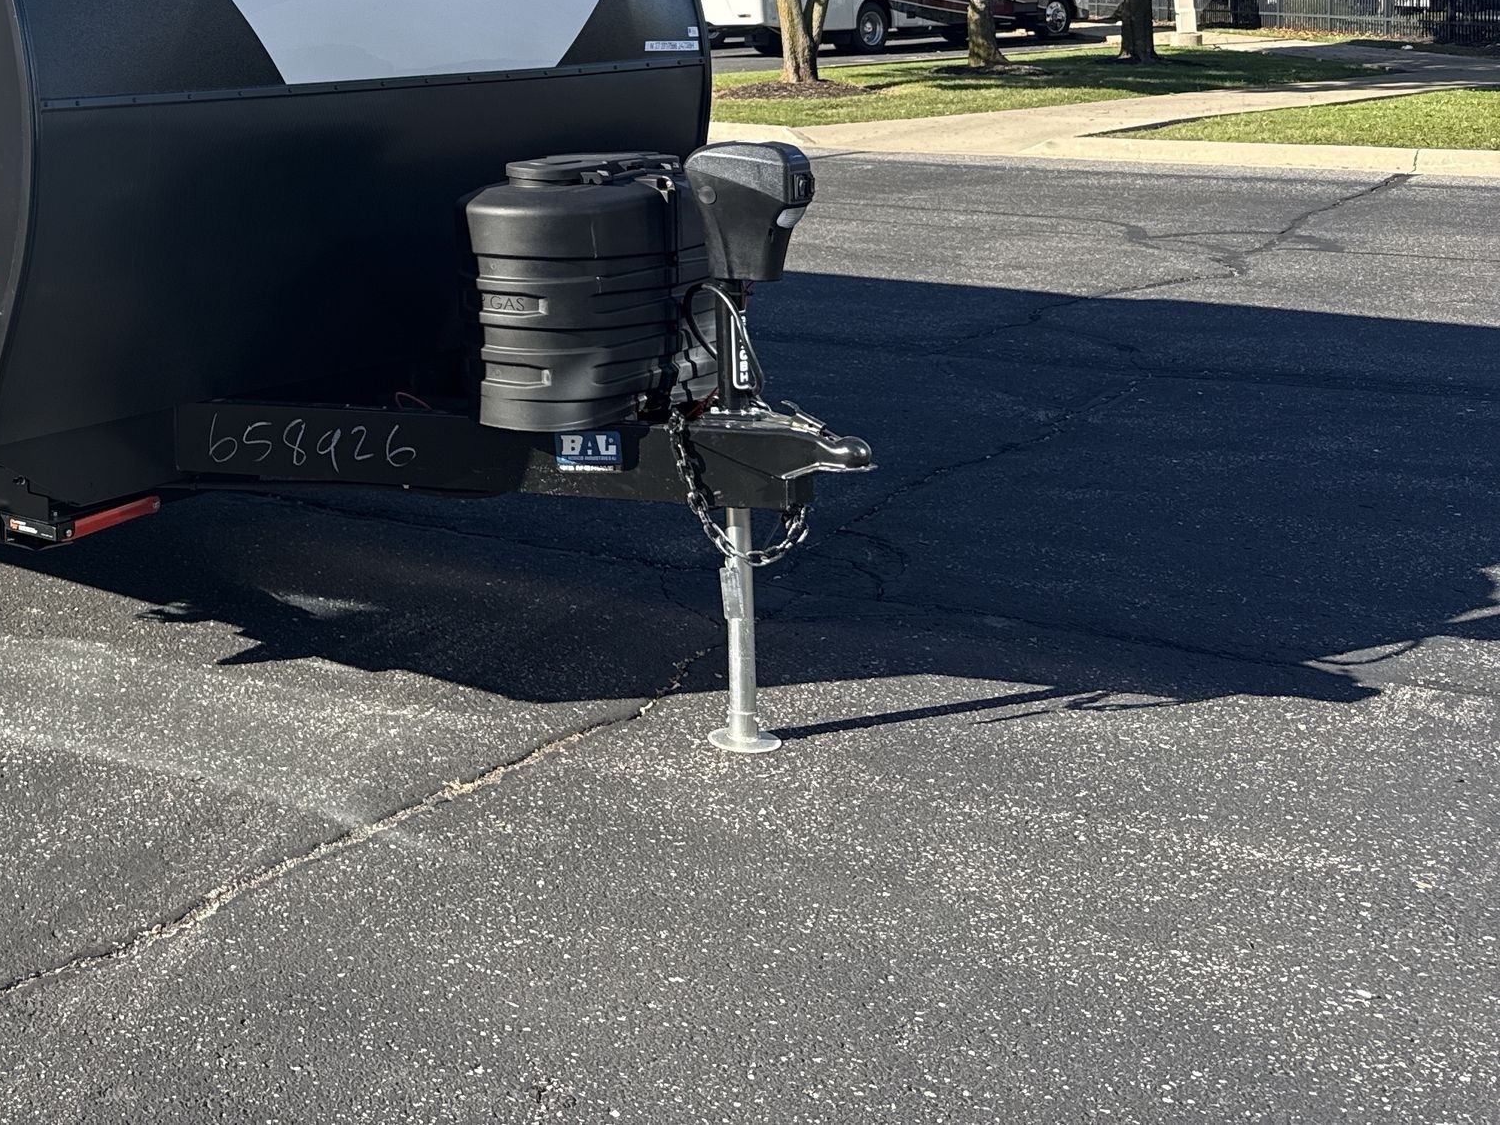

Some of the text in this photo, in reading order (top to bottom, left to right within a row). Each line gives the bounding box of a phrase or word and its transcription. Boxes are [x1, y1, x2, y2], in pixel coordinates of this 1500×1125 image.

[491, 295, 525, 311] GAS
[209, 413, 416, 473] 658926
[561, 435, 616, 455] BAL
